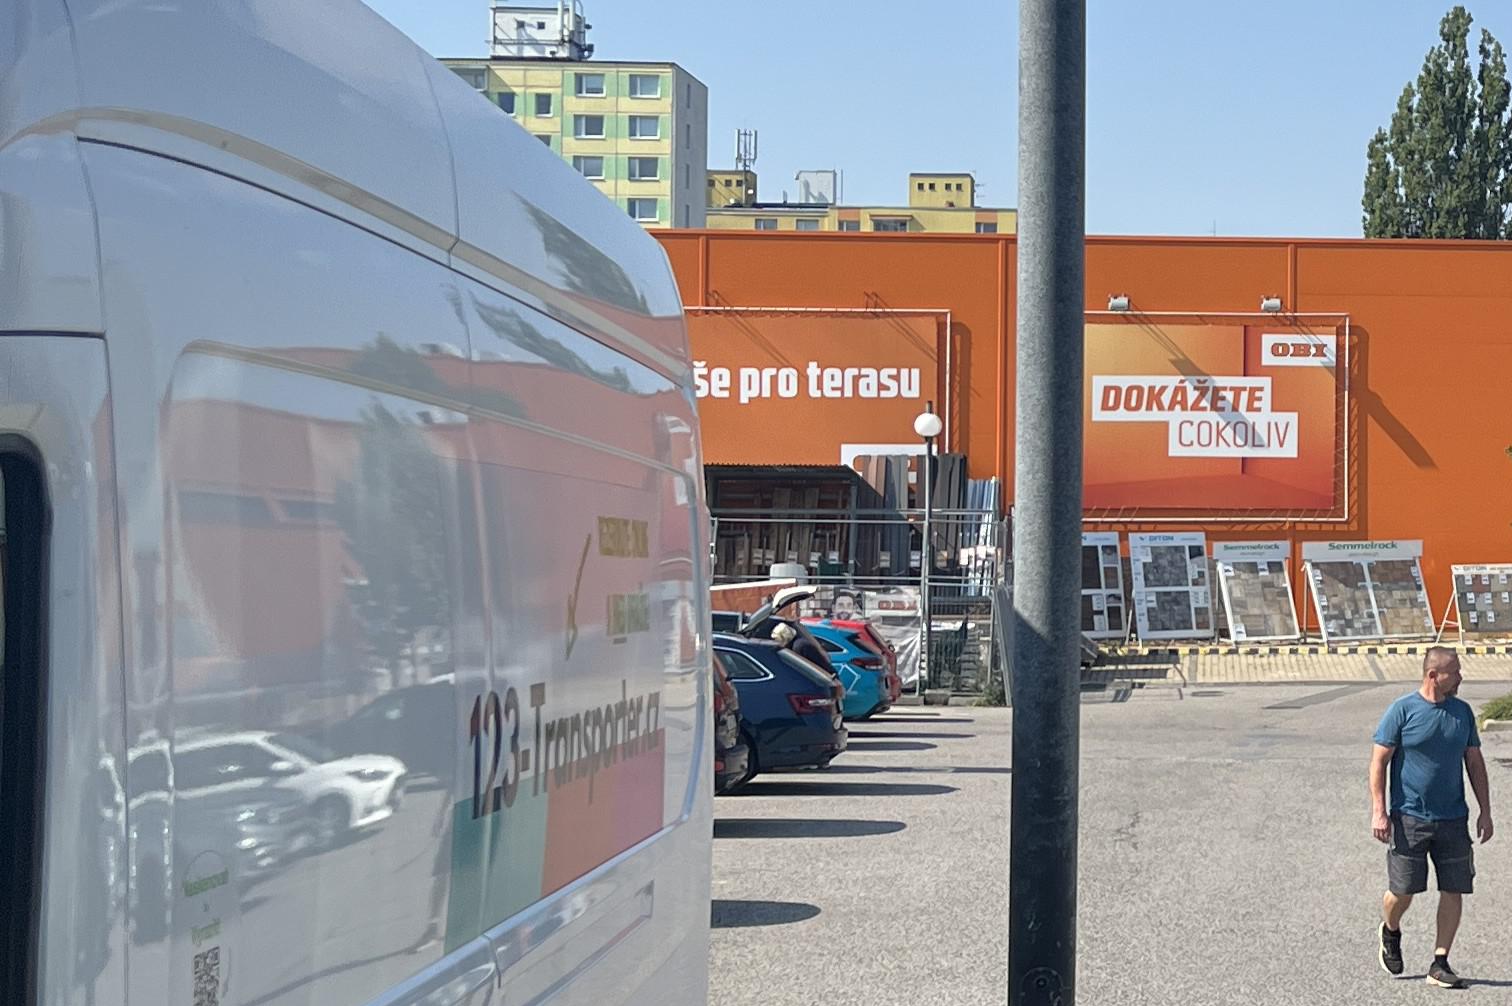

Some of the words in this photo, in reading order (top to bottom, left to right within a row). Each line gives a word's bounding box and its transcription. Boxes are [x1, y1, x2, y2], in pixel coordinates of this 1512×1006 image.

[1270, 342, 1328, 358] OBI
[739, 367, 799, 404] pro
[806, 361, 920, 398] terasu
[1100, 379, 1265, 413] DOKÁŽETE
[1178, 420, 1290, 448] COKOLIV
[1327, 540, 1398, 551] Semmelrock
